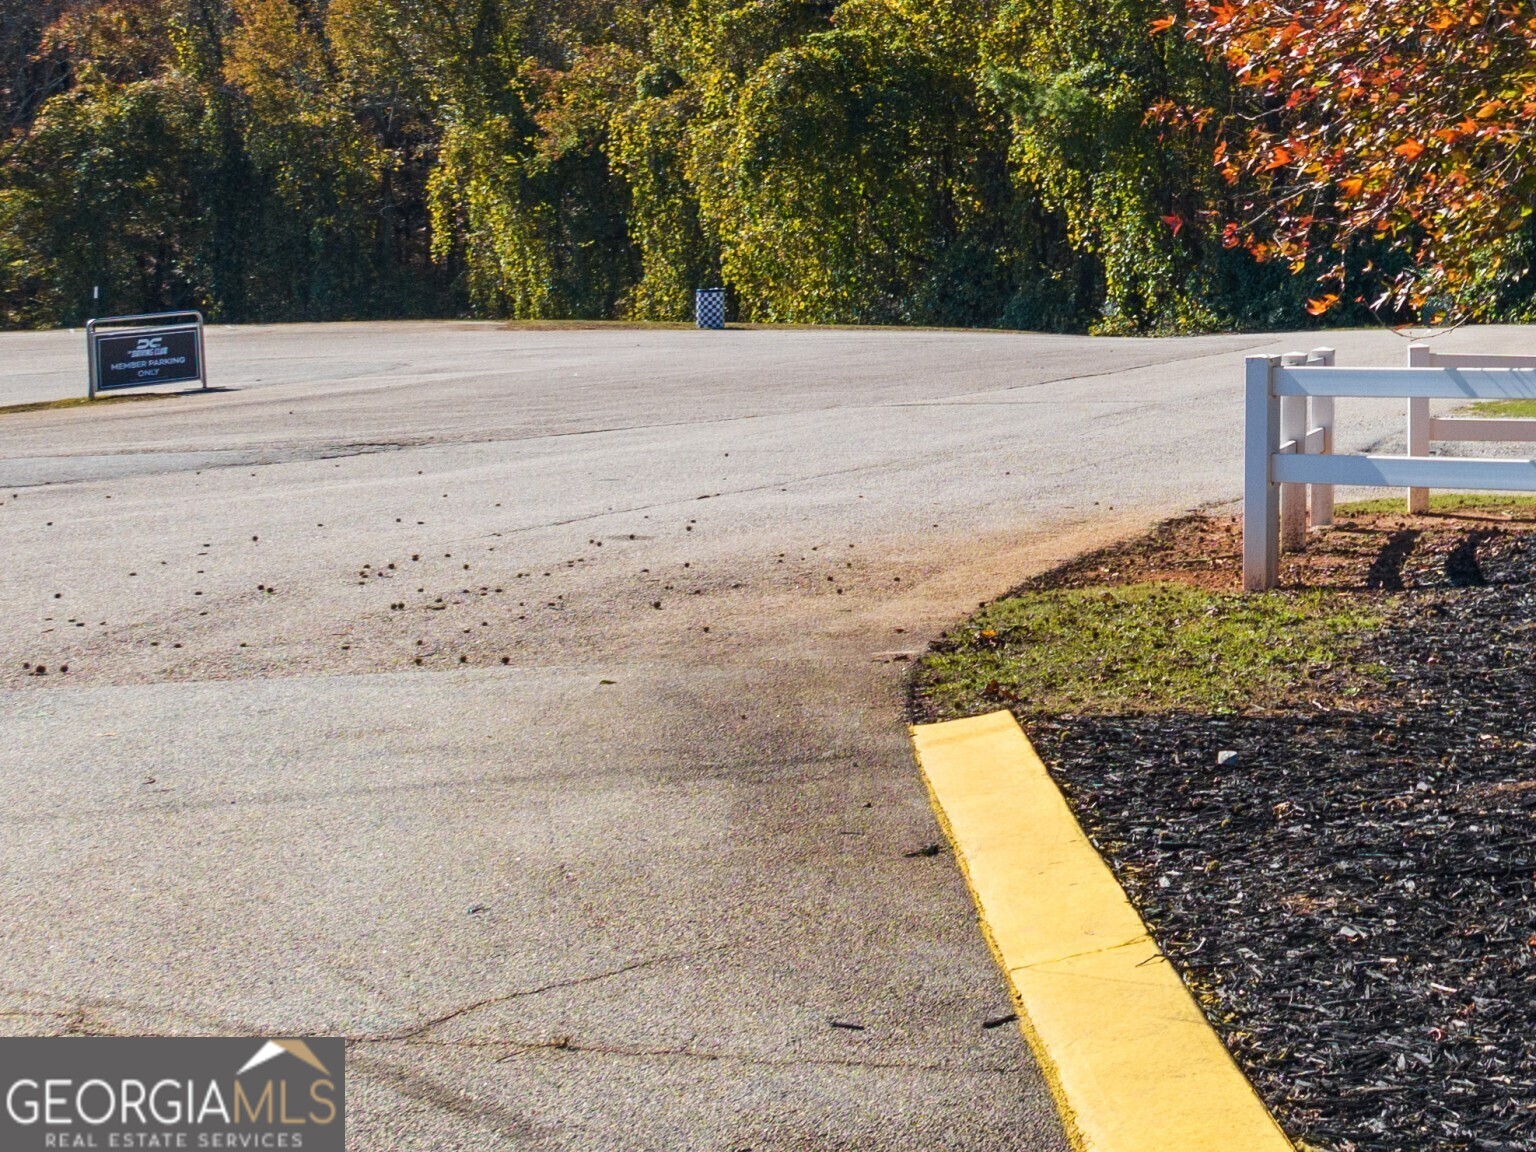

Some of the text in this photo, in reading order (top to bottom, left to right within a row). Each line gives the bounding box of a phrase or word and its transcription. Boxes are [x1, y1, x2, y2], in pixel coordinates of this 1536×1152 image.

[111, 356, 186, 371] MEMBER PARKING
[138, 368, 160, 377] ONLY
